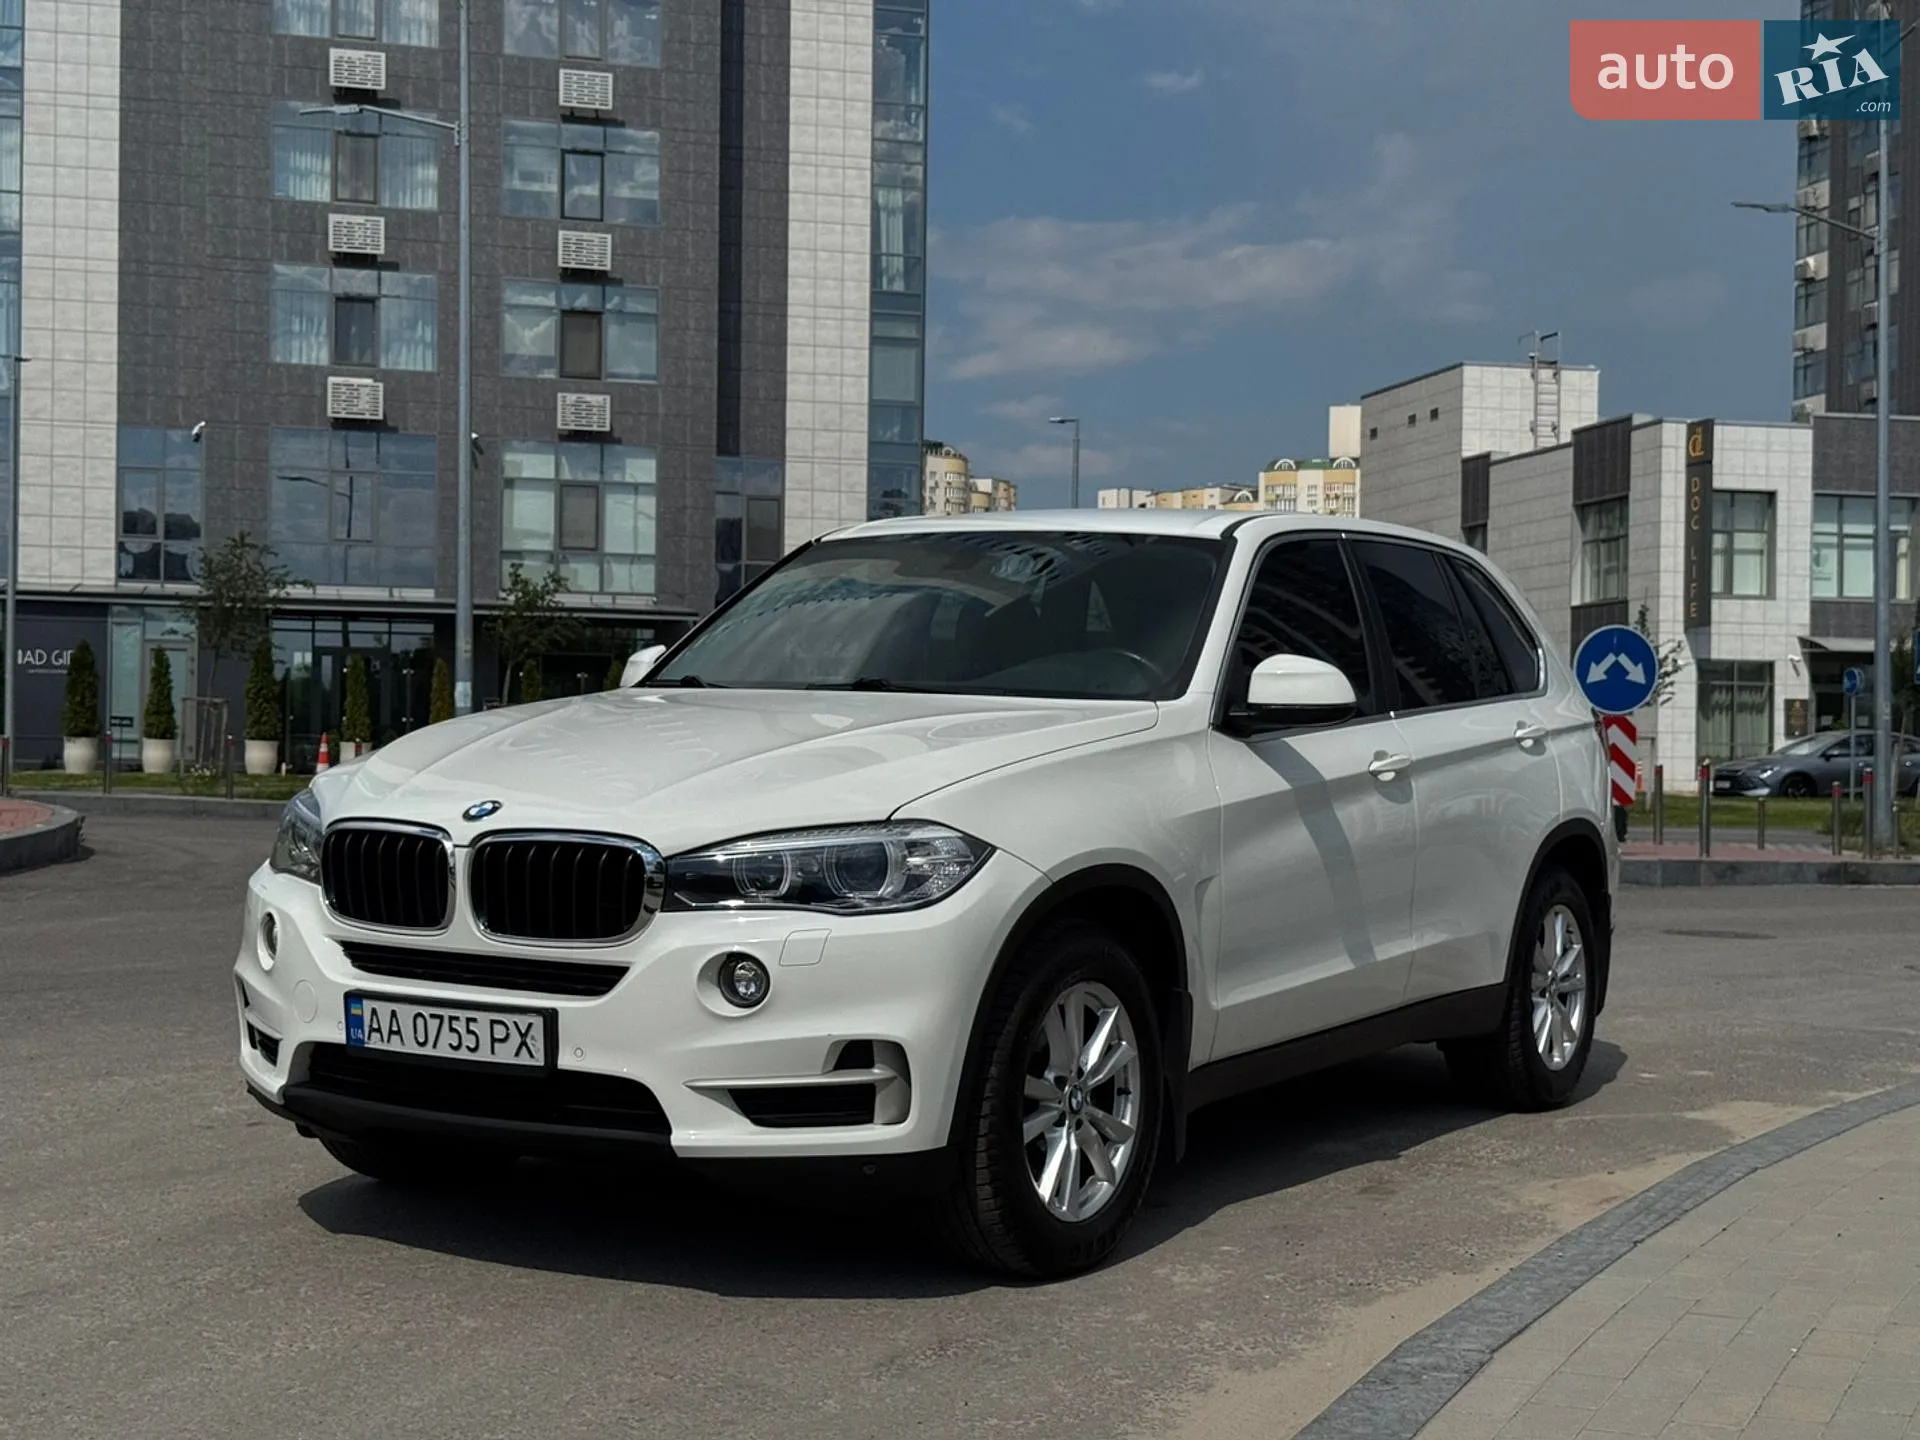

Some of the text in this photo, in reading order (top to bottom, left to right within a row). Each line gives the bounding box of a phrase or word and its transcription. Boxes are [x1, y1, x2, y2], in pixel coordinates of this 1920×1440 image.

[1690, 477, 1701, 617] DOC LIFE
[350, 1028, 363, 1040] UA
[367, 1007, 535, 1059] AA 0755 PX
